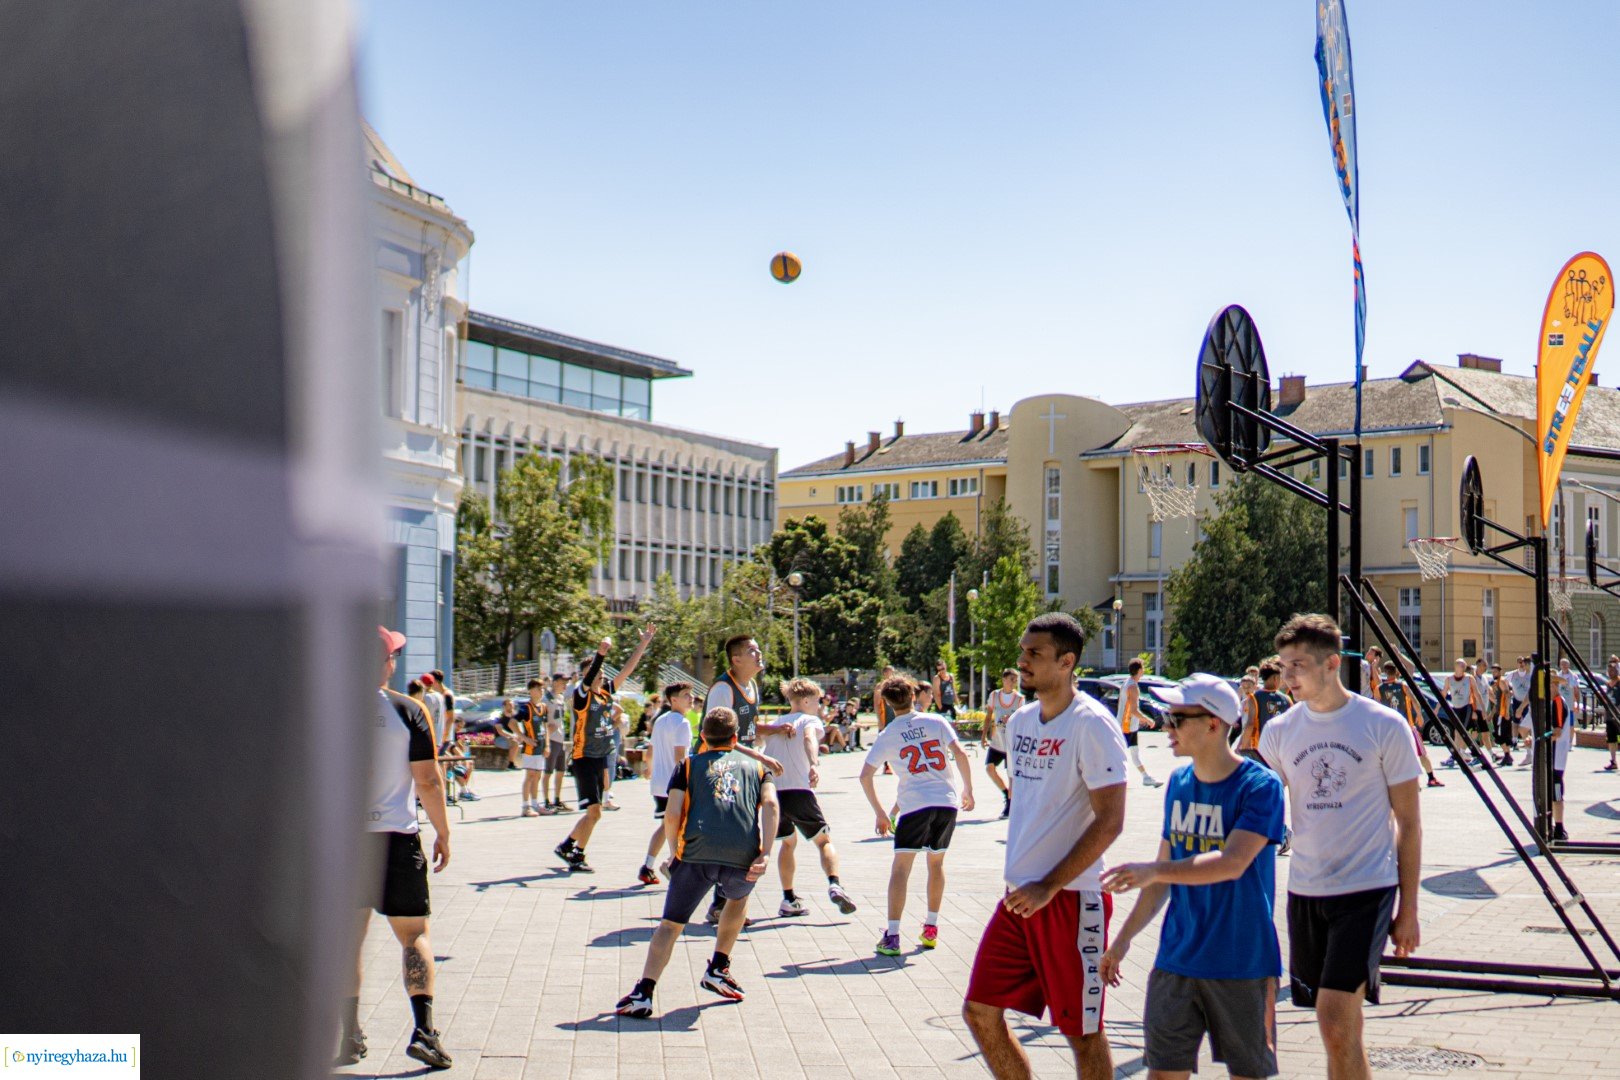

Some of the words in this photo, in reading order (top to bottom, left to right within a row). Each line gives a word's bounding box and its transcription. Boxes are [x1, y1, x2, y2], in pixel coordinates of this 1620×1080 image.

[900, 726, 927, 743] ROSE
[1037, 738, 1067, 756] 2K
[899, 739, 947, 775] 25
[1170, 799, 1225, 837] MTA
[1082, 902, 1101, 1014] JORDAN
